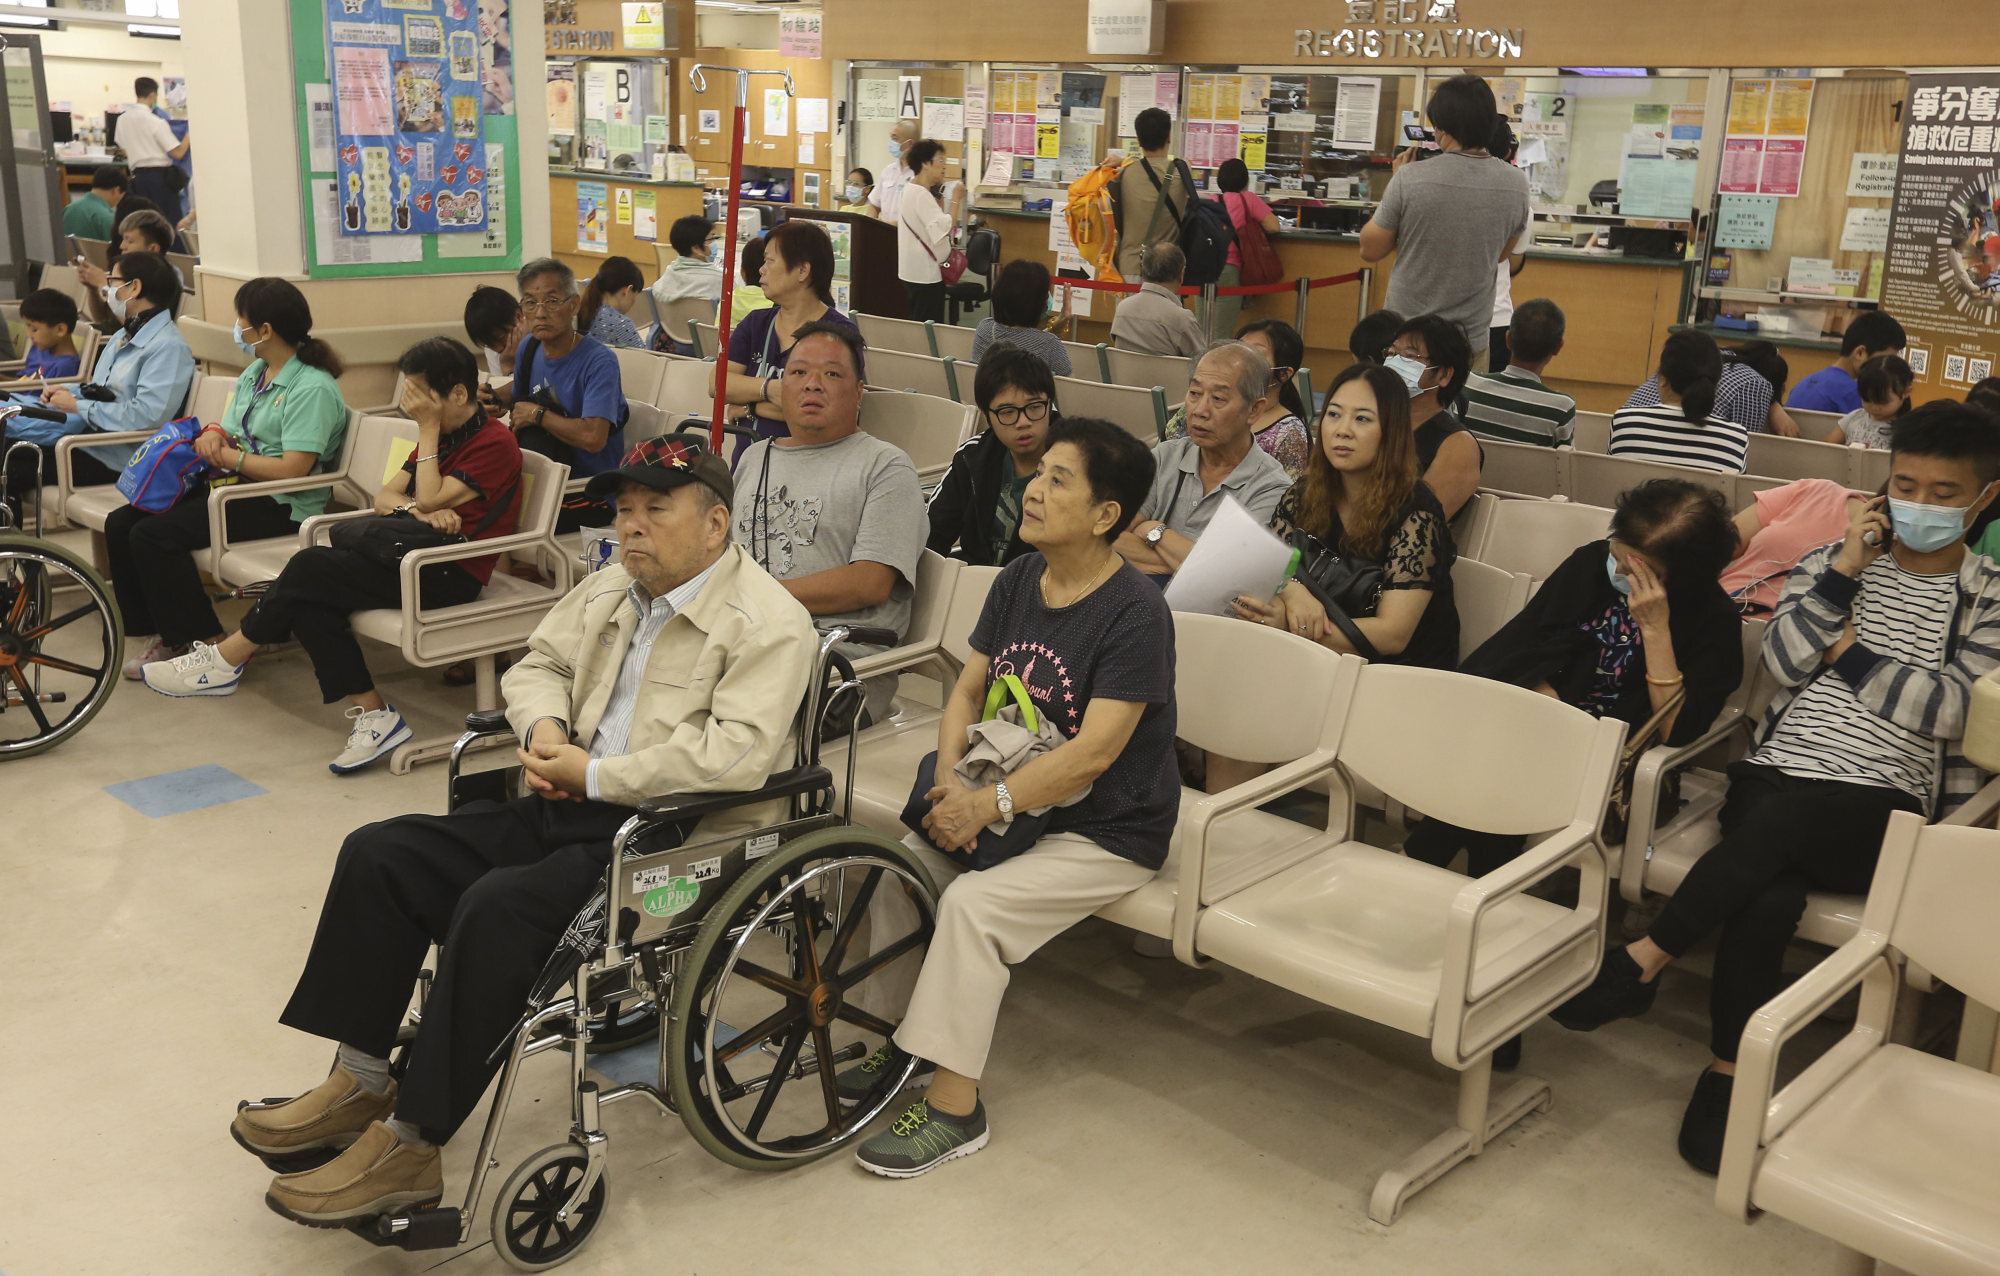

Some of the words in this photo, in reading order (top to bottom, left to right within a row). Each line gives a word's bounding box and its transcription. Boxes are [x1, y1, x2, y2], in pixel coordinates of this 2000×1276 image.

[552, 30, 614, 50] STATION
[1294, 28, 1524, 59] REGISTRATION
[616, 69, 630, 103] B
[900, 80, 918, 116] A
[1551, 97, 1566, 117] 2
[1912, 86, 2000, 121] 爭分奪
[1891, 100, 1904, 122] 1
[1904, 154, 1927, 165] Saving
[1927, 154, 1945, 165] Lives
[1945, 157, 1953, 165] on
[1953, 157, 1959, 166] a
[1959, 155, 1974, 166] Fast
[1975, 157, 1994, 167] Track
[1855, 182, 1896, 193] Registrati
[1861, 173, 1896, 182] Follow-u
[648, 890, 695, 910] ALPHA
